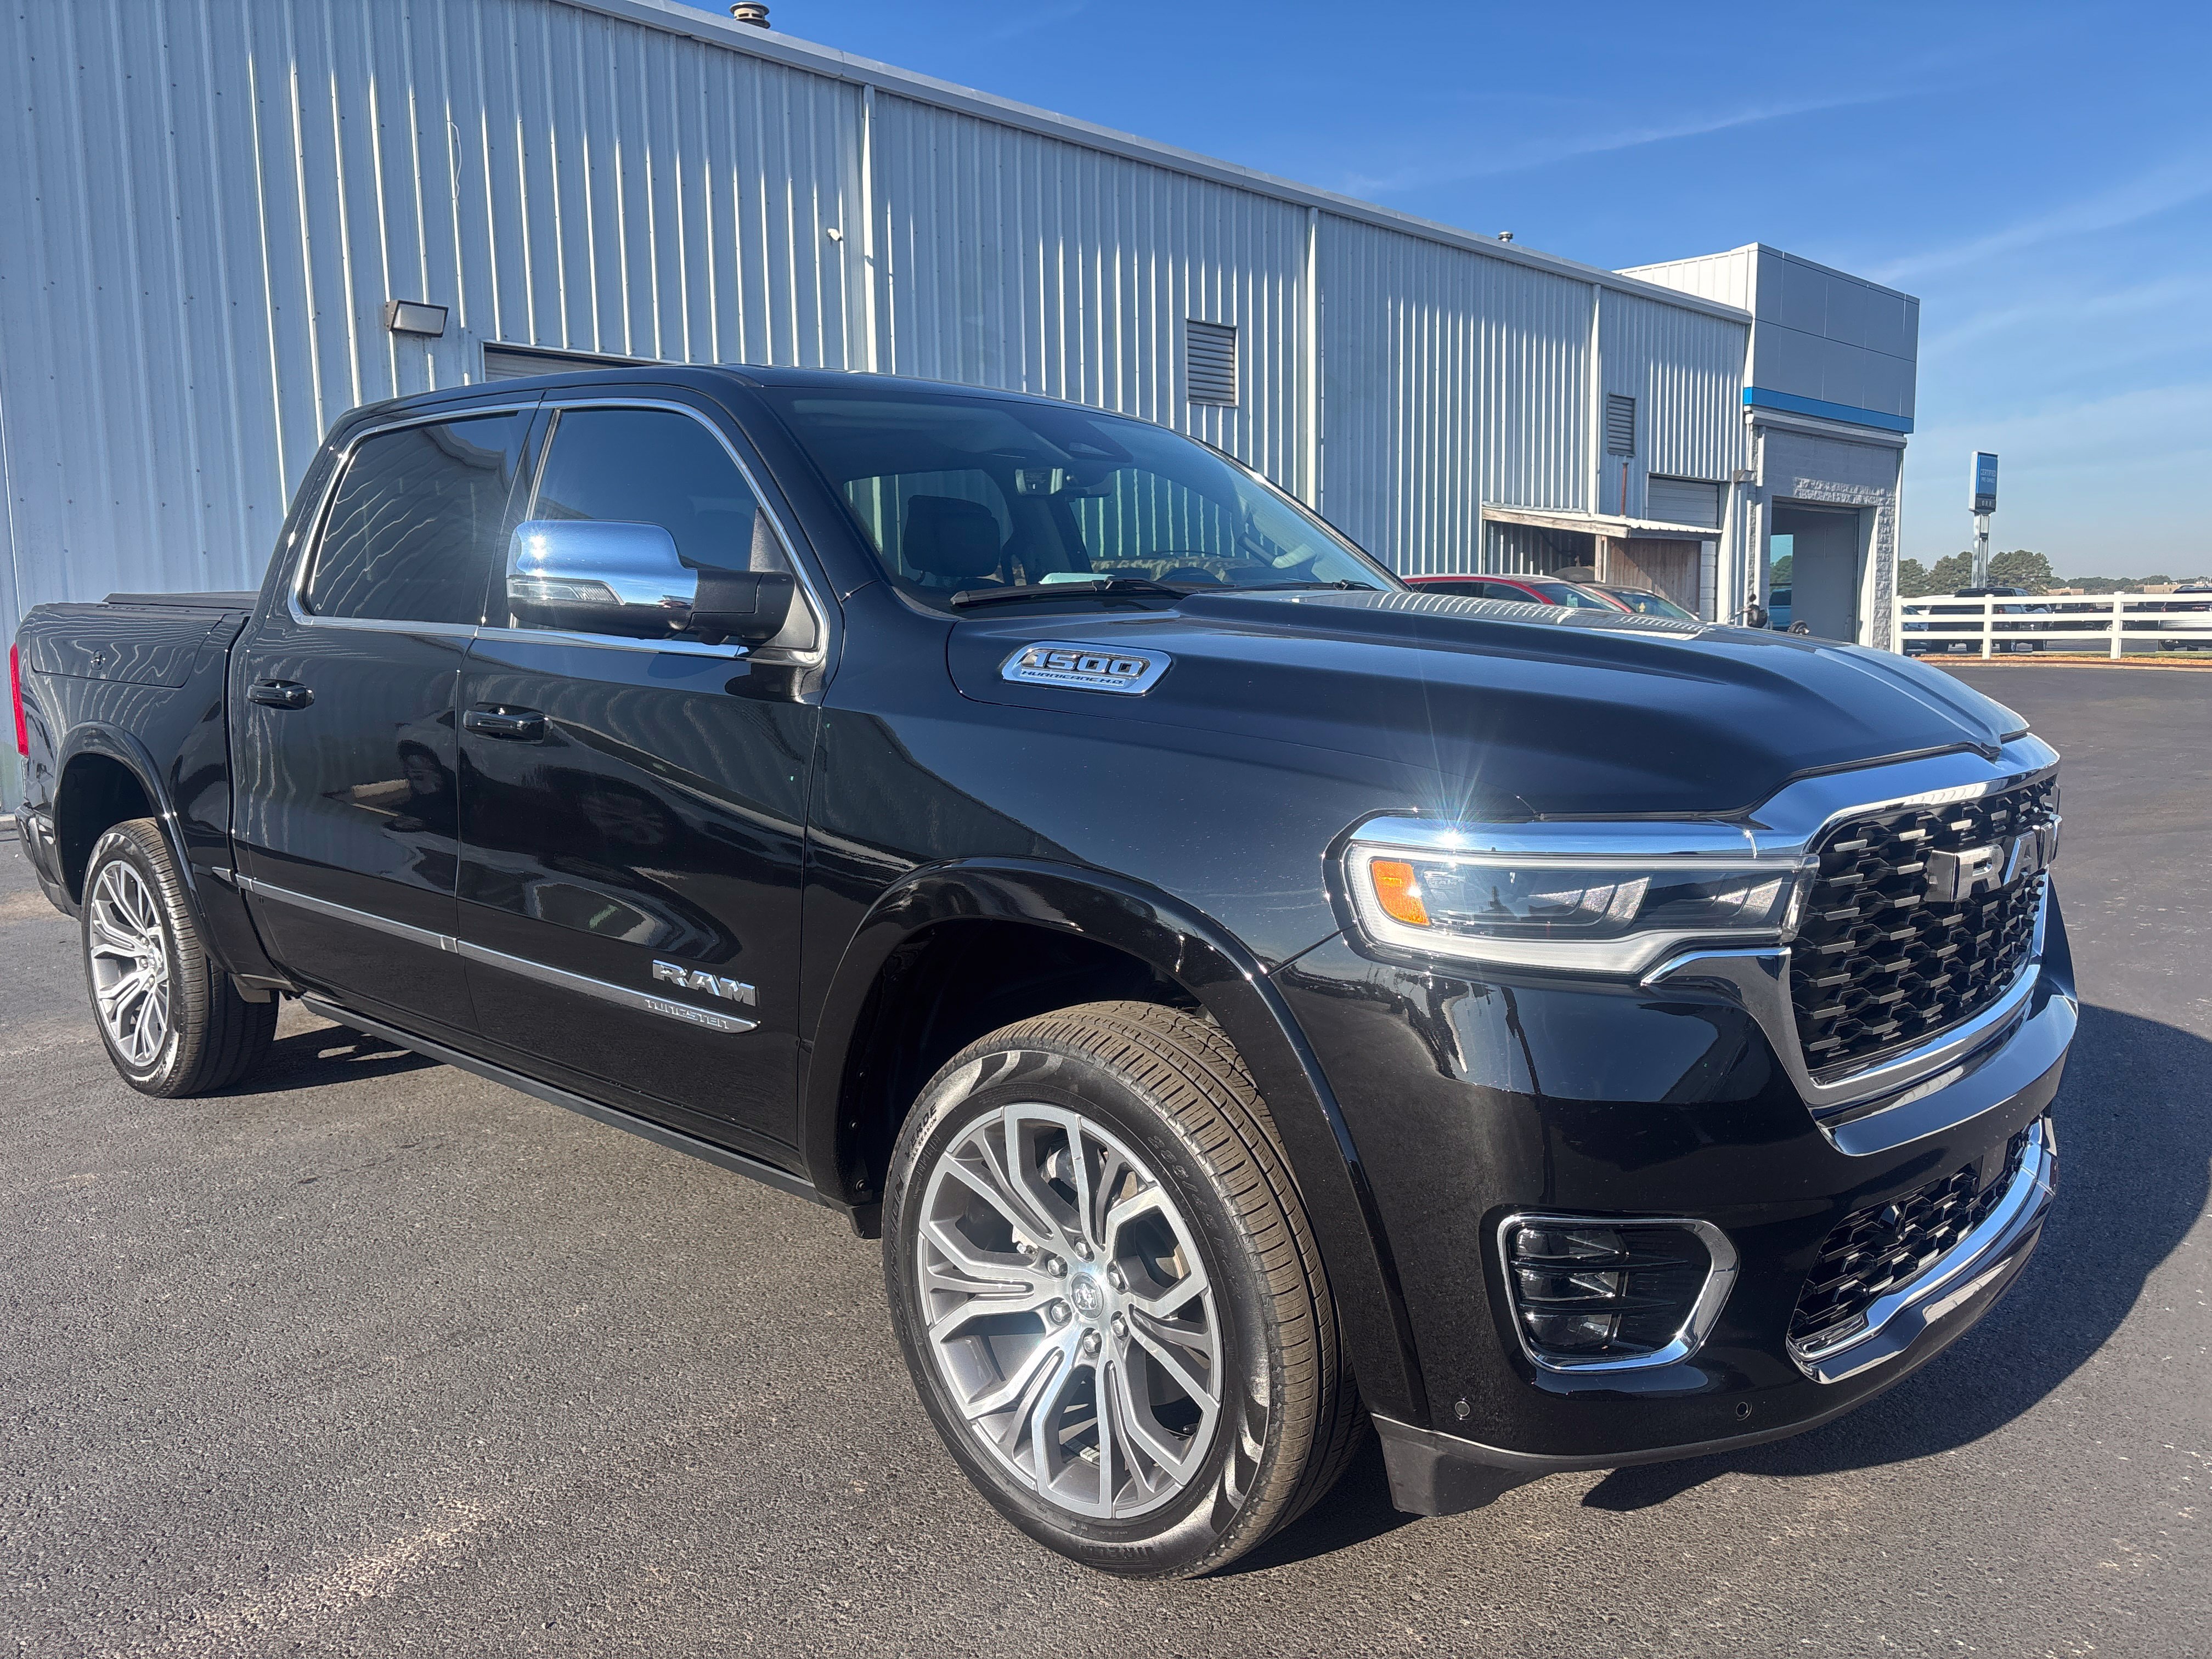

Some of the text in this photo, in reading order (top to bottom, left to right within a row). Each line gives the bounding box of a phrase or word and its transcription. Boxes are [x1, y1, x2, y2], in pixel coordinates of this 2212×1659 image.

[1021, 670, 1097, 682] HURRICANE
[1034, 651, 1142, 676] 1500
[652, 959, 760, 1006] RAM
[644, 998, 730, 1030] TUNGSTEN
[905, 1101, 937, 1160] VERDE
